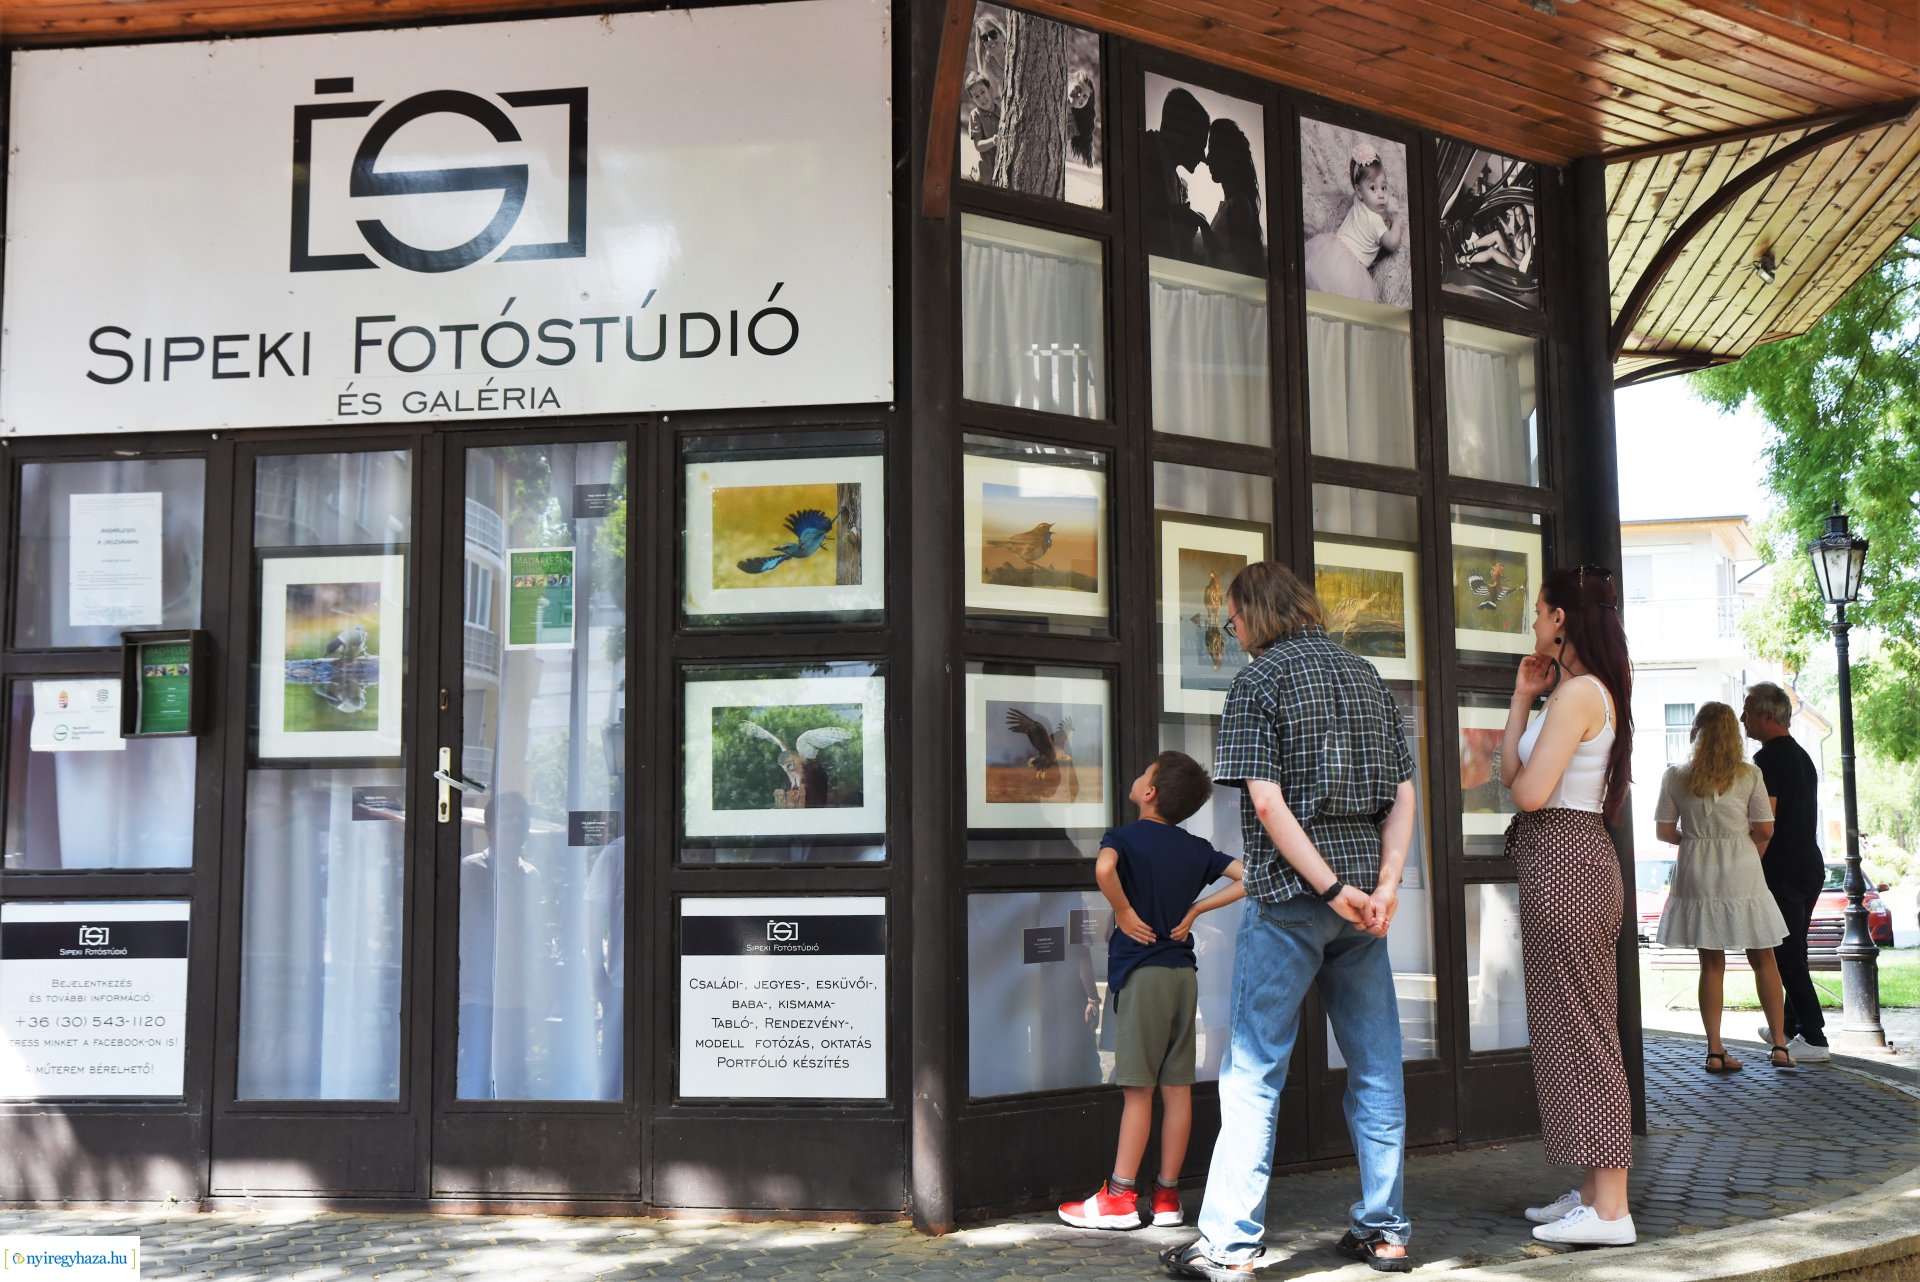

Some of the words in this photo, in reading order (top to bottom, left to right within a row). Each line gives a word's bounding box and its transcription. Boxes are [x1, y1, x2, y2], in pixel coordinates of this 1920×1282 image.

[86, 325, 311, 385] SIPEKI
[353, 281, 800, 375] FOTÓSTÚDIÓ
[337, 381, 383, 417] ÉS
[401, 377, 561, 415] GALÉRIA
[746, 944, 771, 952] SIPEKI
[773, 942, 820, 952] FOTÓSTÚDIÓ
[51, 977, 133, 988] BEJELENTKEZÉS
[689, 977, 748, 990] CSALÁDI-,
[753, 980, 810, 991] JEGYES-,
[29, 993, 42, 1003] ÉS
[46, 993, 87, 1003] TOVÁBBI
[732, 1000, 772, 1010] BABA-,
[778, 1000, 836, 1010] KISMAMA-
[15, 1016, 50, 1028] +36
[55, 1016, 88, 1028] (30)
[92, 1016, 166, 1028] 543-1120
[711, 1015, 758, 1030] TABLÓ-,
[765, 1015, 854, 1031] RENDEZVÉNY-,
[44, 1039, 79, 1047] MINKET
[83, 1039, 89, 1047] A
[93, 1038, 162, 1047] FACEBOOK-ON
[695, 1039, 745, 1049] MODELL
[755, 1035, 815, 1050] FOTÓZÁS,
[820, 1035, 872, 1049] OKTATÁS
[717, 1054, 788, 1069] PORTFÓLIÓ
[793, 1054, 850, 1069] KÉSZÍTÉS
